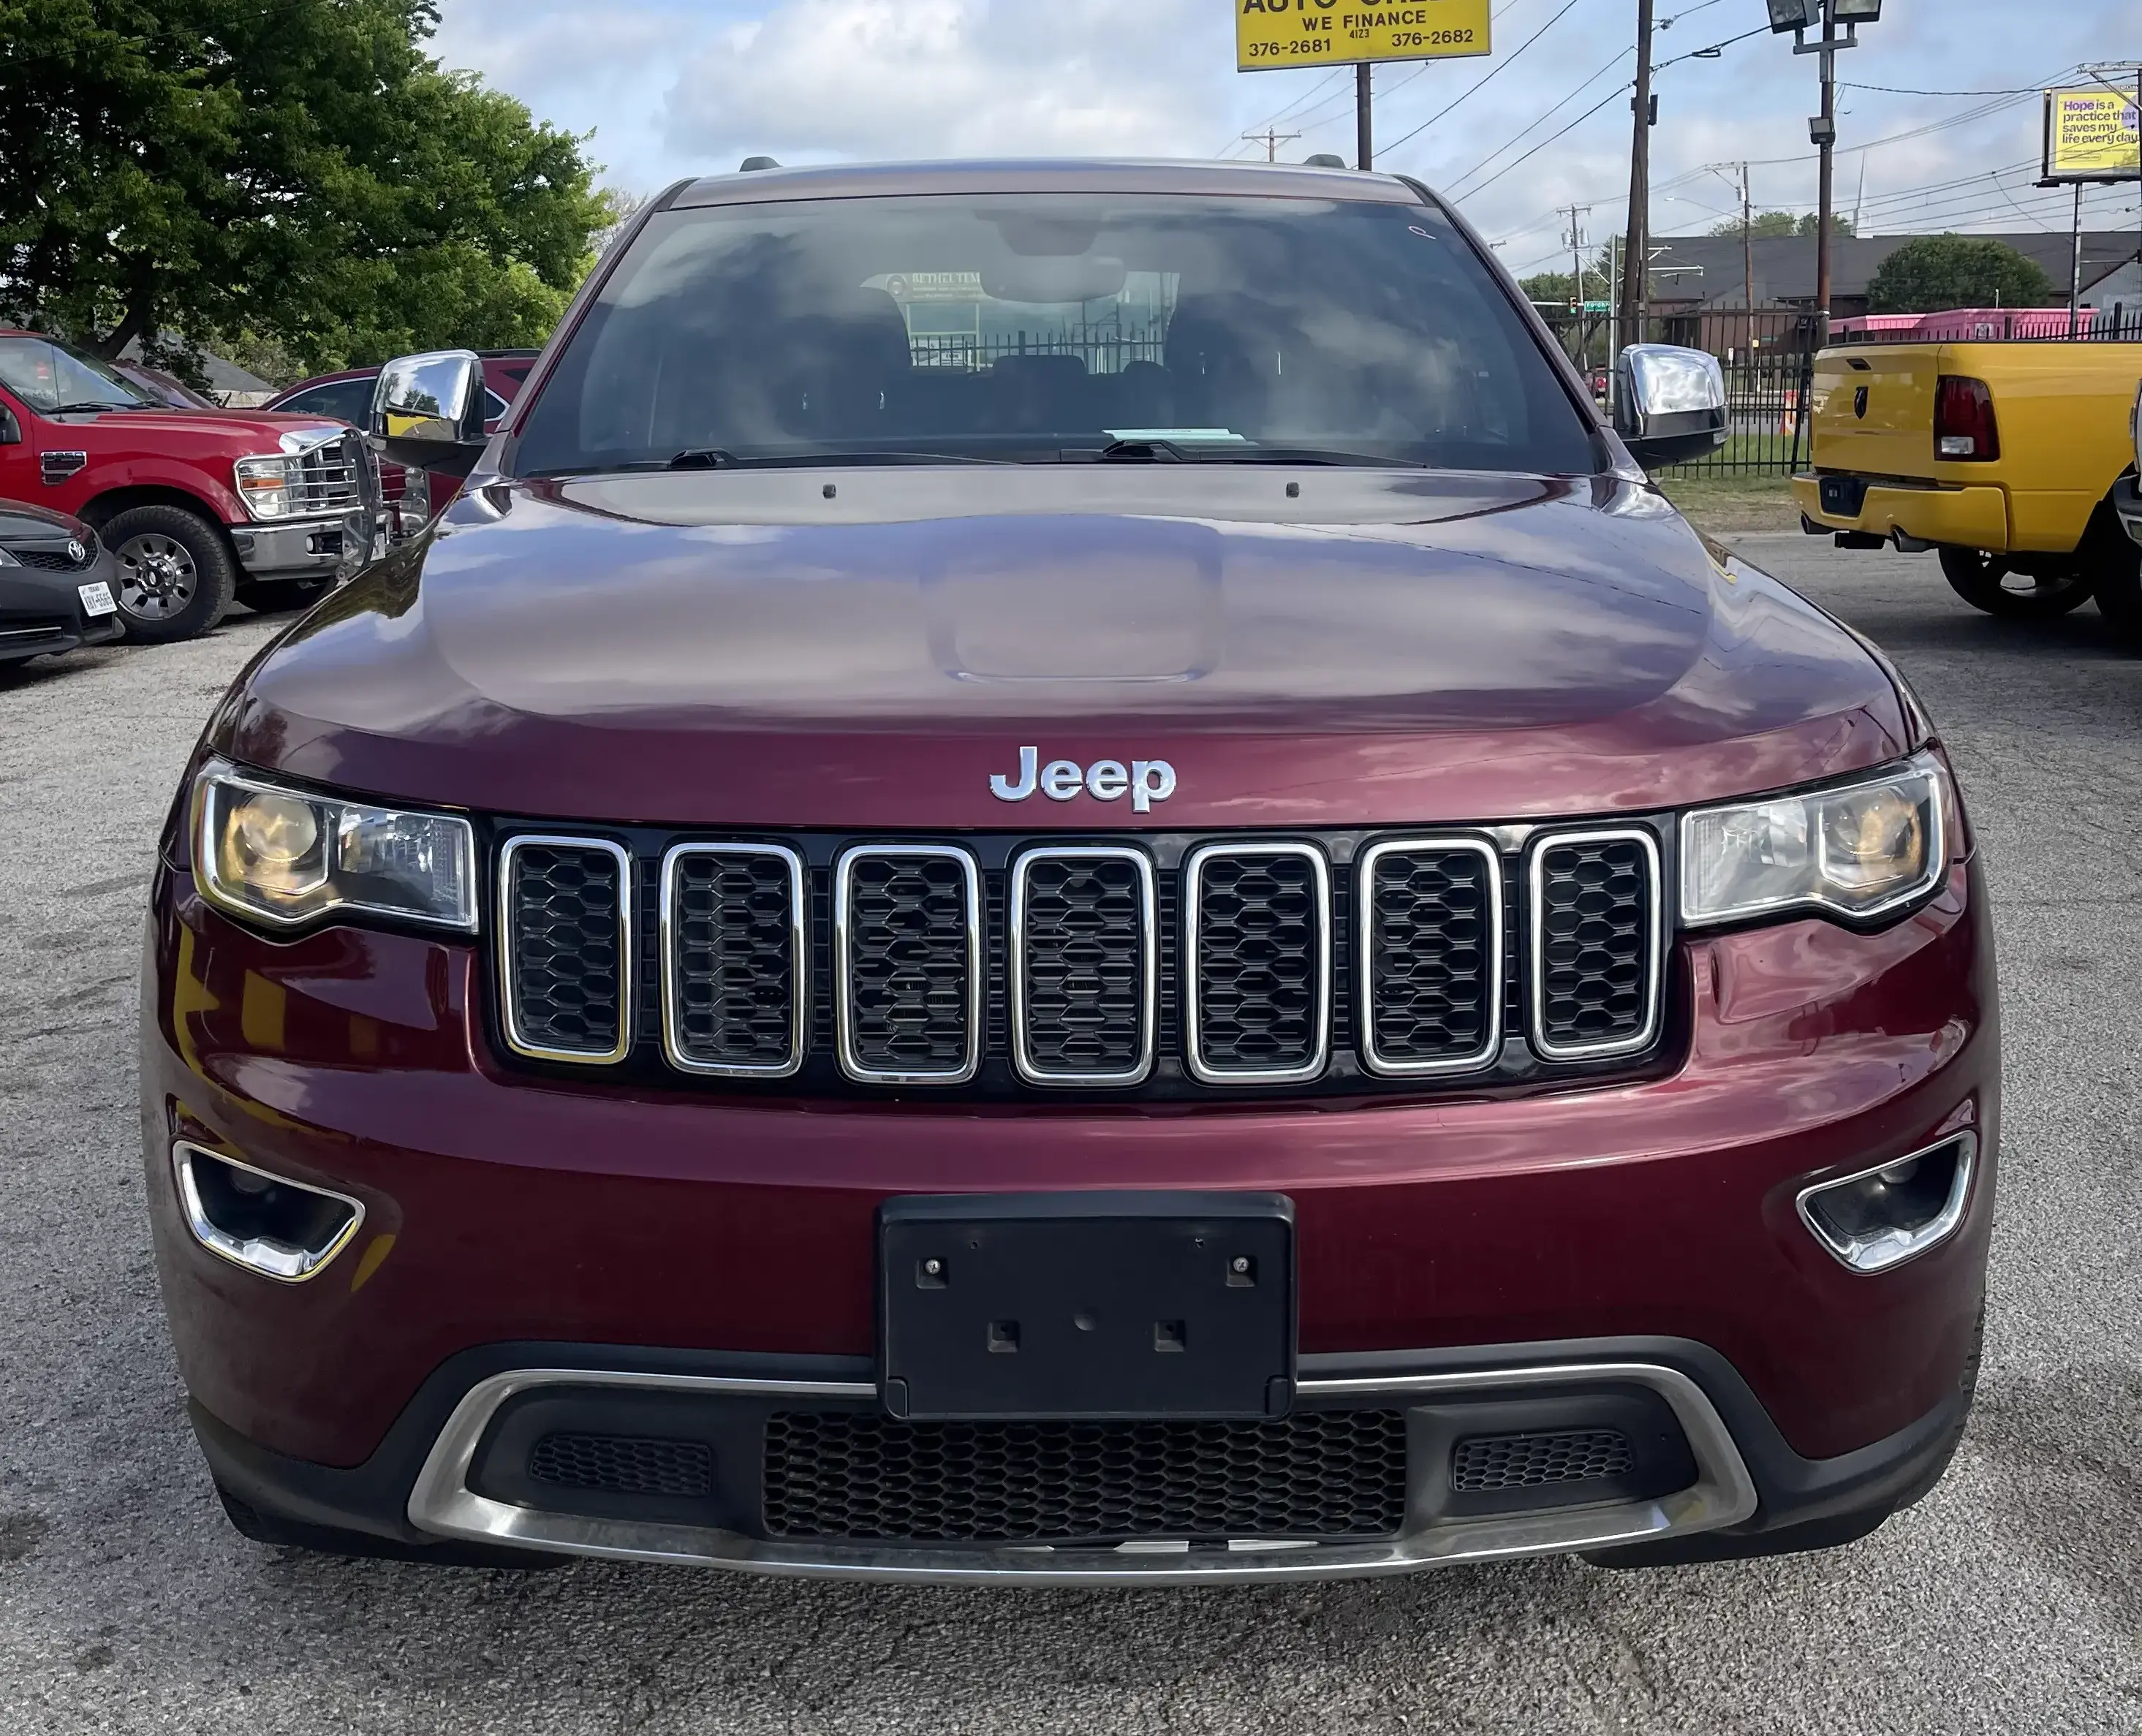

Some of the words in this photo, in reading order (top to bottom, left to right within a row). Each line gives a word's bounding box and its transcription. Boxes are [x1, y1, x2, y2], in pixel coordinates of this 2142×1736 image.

[1302, 17, 1332, 31] WE
[1343, 10, 1426, 29] FINANCE
[1350, 29, 1369, 39] 4123
[1391, 29, 1473, 47] 376-2682
[1249, 38, 1331, 57] 376-2681
[2096, 99, 2105, 110] is
[2107, 102, 2114, 110] a
[2063, 110, 2111, 124] practice
[2113, 110, 2136, 120] that
[2062, 124, 2096, 132] saves
[2098, 123, 2117, 133] my
[2062, 133, 2080, 143] life
[2081, 134, 2115, 144] every
[989, 746, 1176, 813] Jeep
